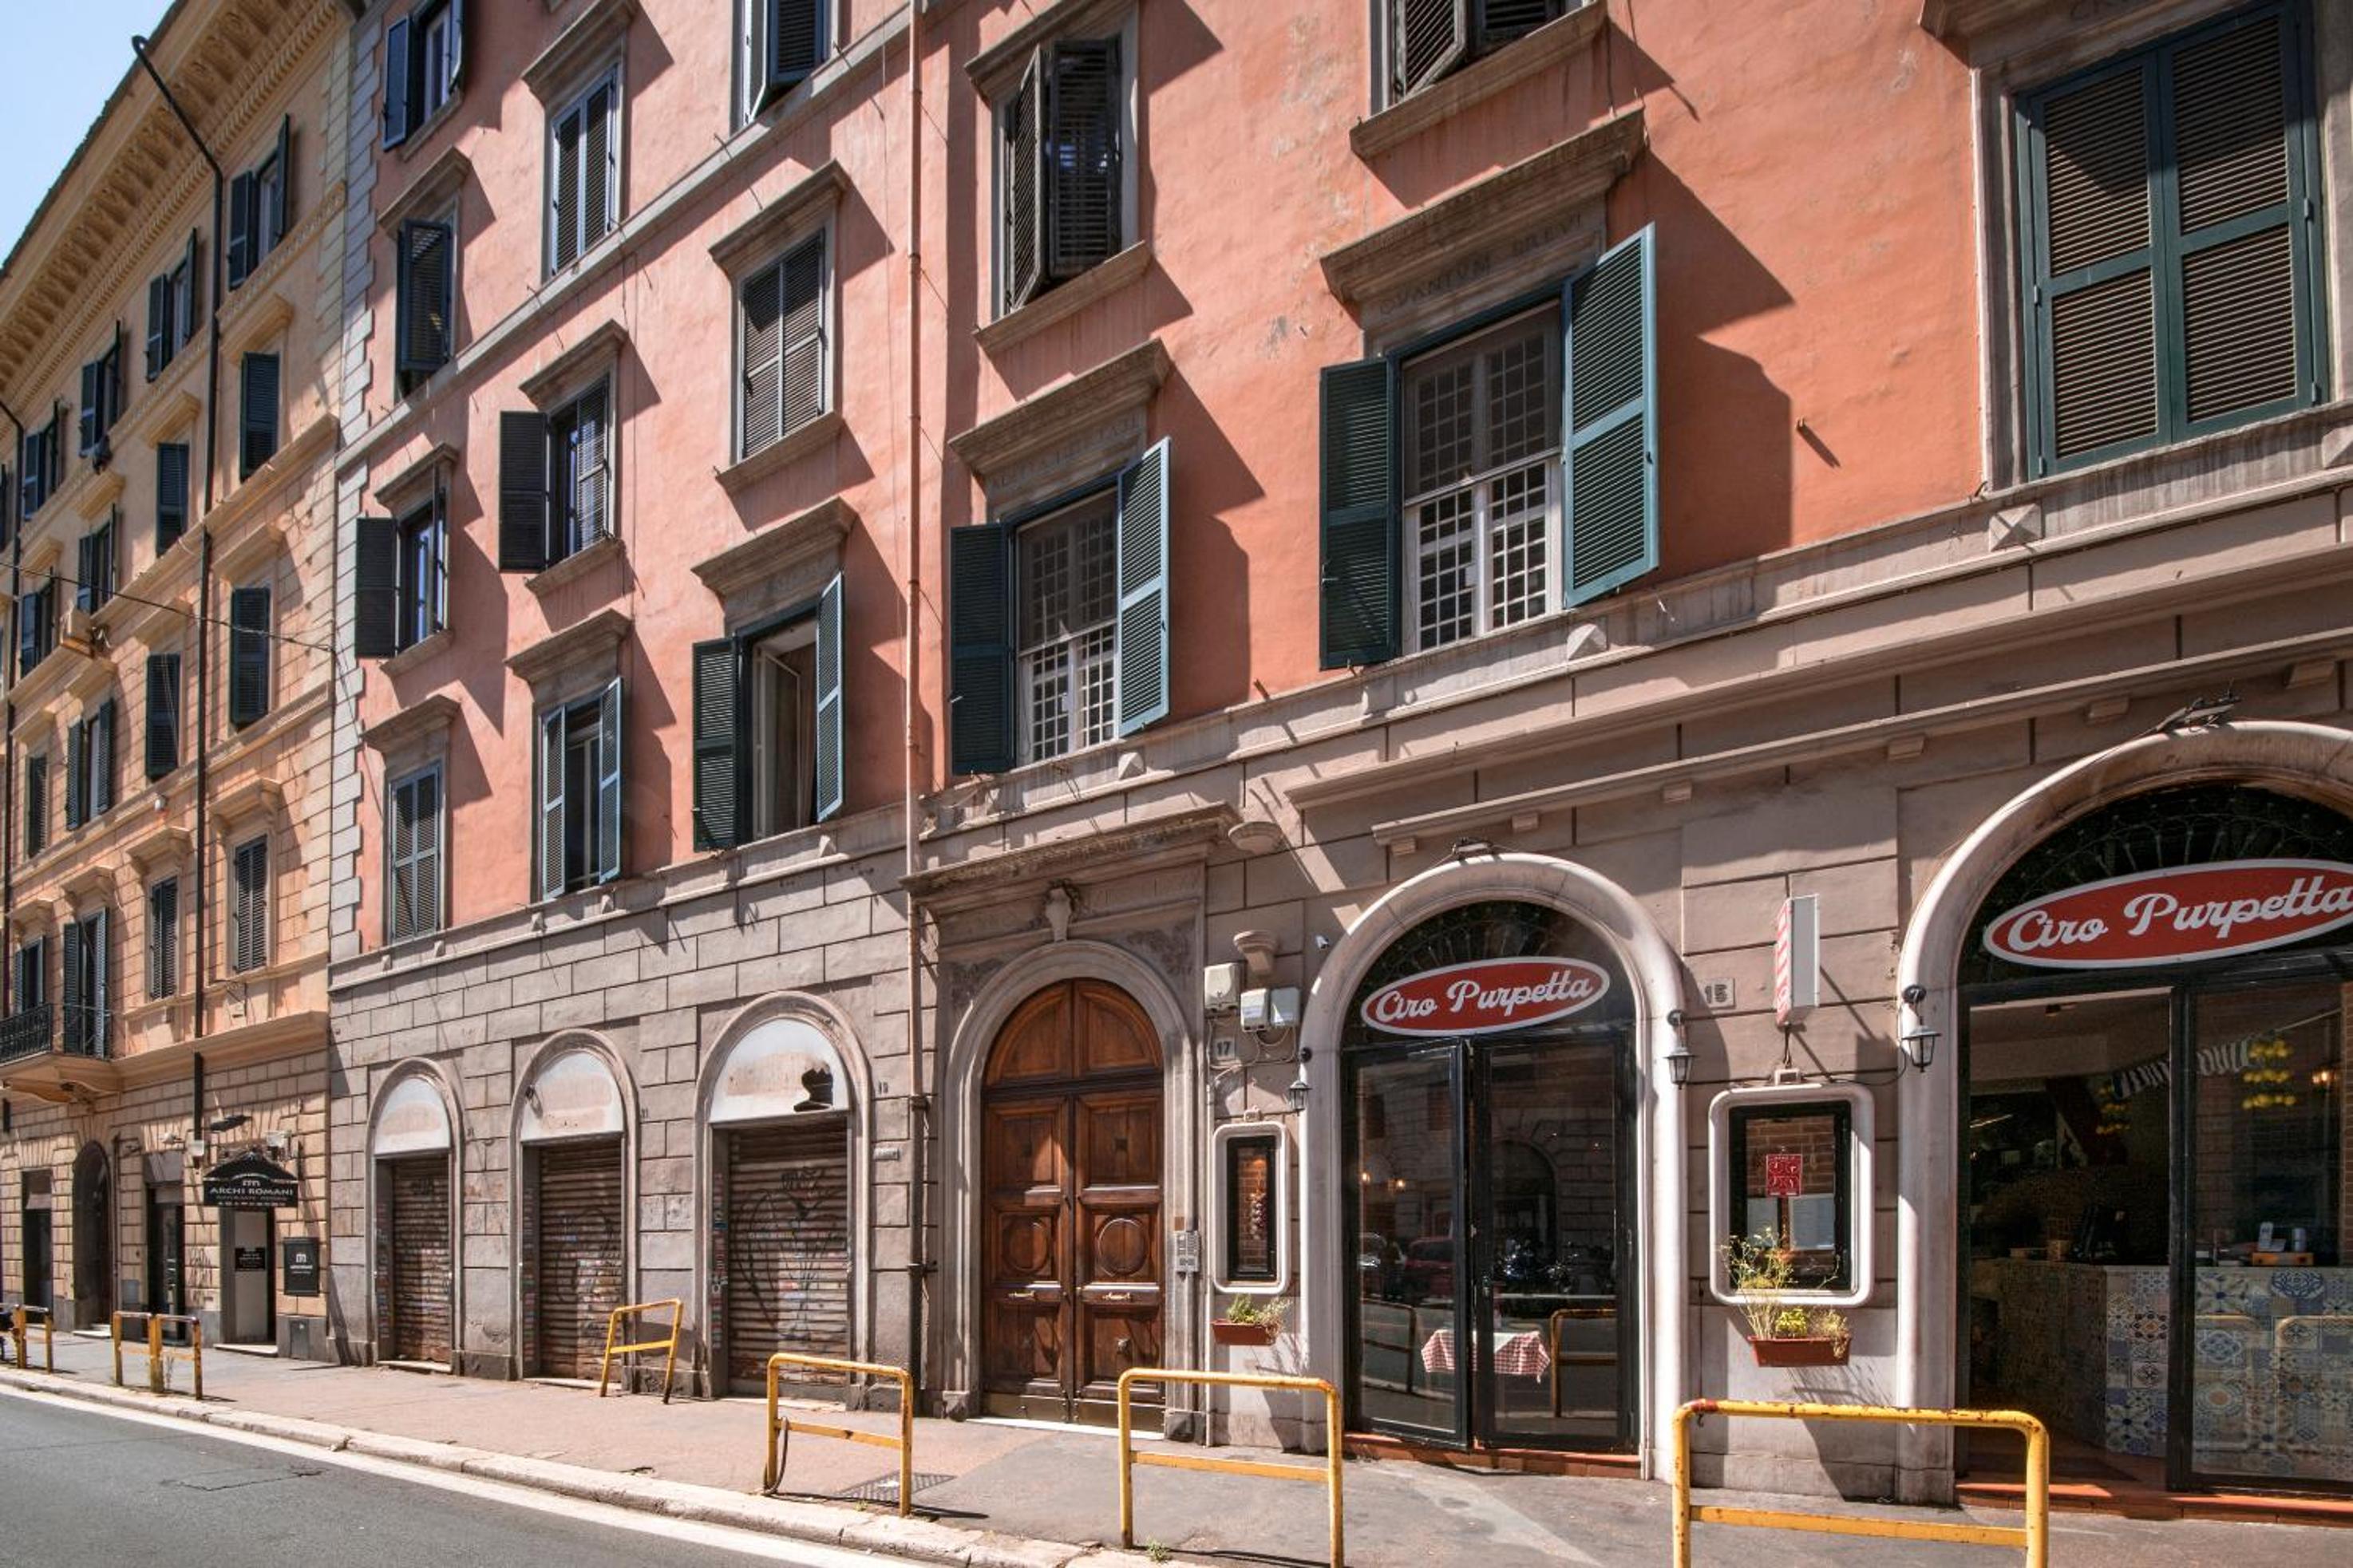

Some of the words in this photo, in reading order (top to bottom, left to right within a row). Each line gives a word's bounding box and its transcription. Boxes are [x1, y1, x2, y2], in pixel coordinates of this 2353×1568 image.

[2006, 910, 2109, 952] Ciro
[2123, 875, 2353, 939] Purpetta
[1375, 989, 1438, 1024] Ciro
[1446, 969, 1595, 1017] Purpetta
[1704, 983, 1728, 1004] 15
[1217, 1041, 1232, 1057] 17
[210, 1187, 245, 1195] ARCHI
[248, 1187, 294, 1196] ROMANI
